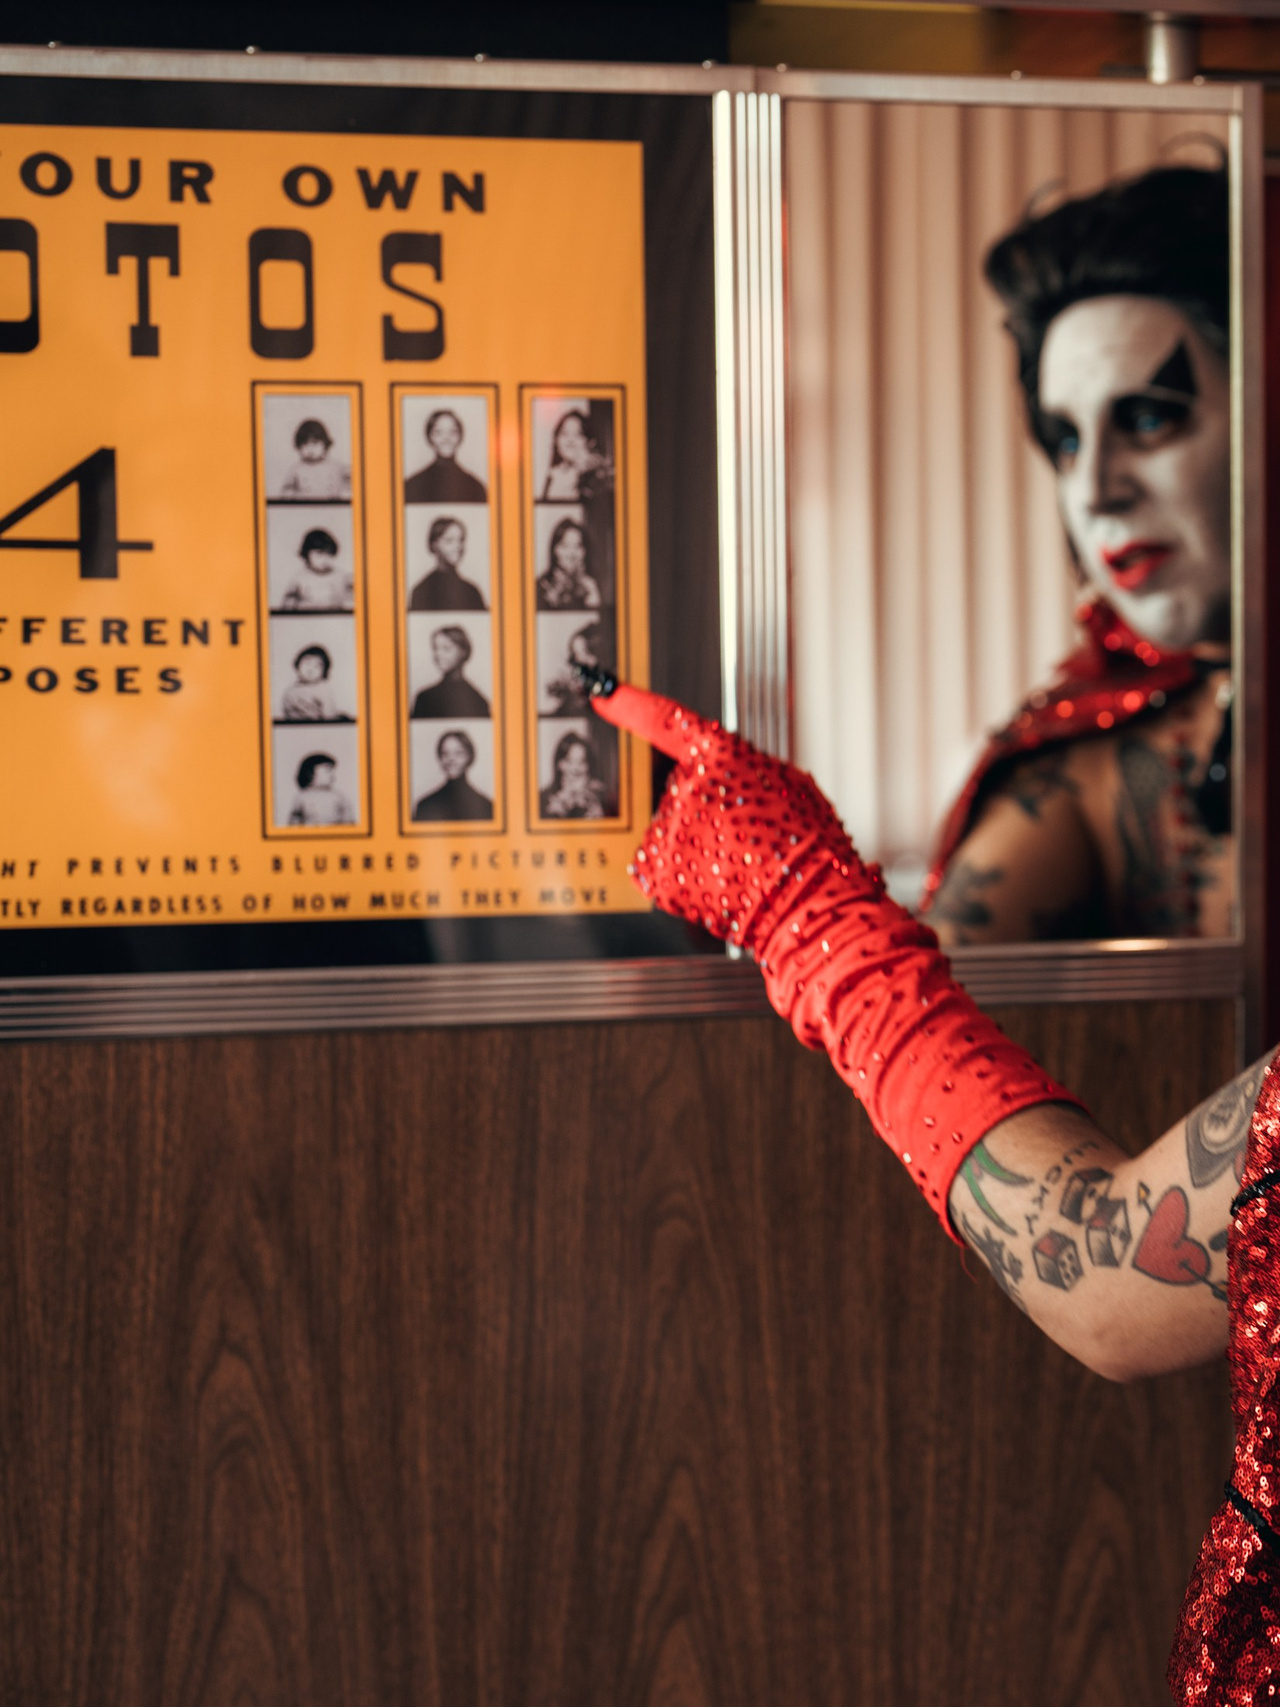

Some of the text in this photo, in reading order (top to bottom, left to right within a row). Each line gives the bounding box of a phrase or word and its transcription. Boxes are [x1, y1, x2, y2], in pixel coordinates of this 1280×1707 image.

[281, 164, 486, 214] OWN
[0, 216, 446, 362] OTOS
[0, 446, 155, 580] 4
[66, 856, 240, 876] PREVENTS
[271, 853, 419, 874] BLURRED
[449, 848, 609, 870] PICTURES
[0, 887, 608, 919] TLY REGARDLESS OF HOW MUCH THEY MOVE
